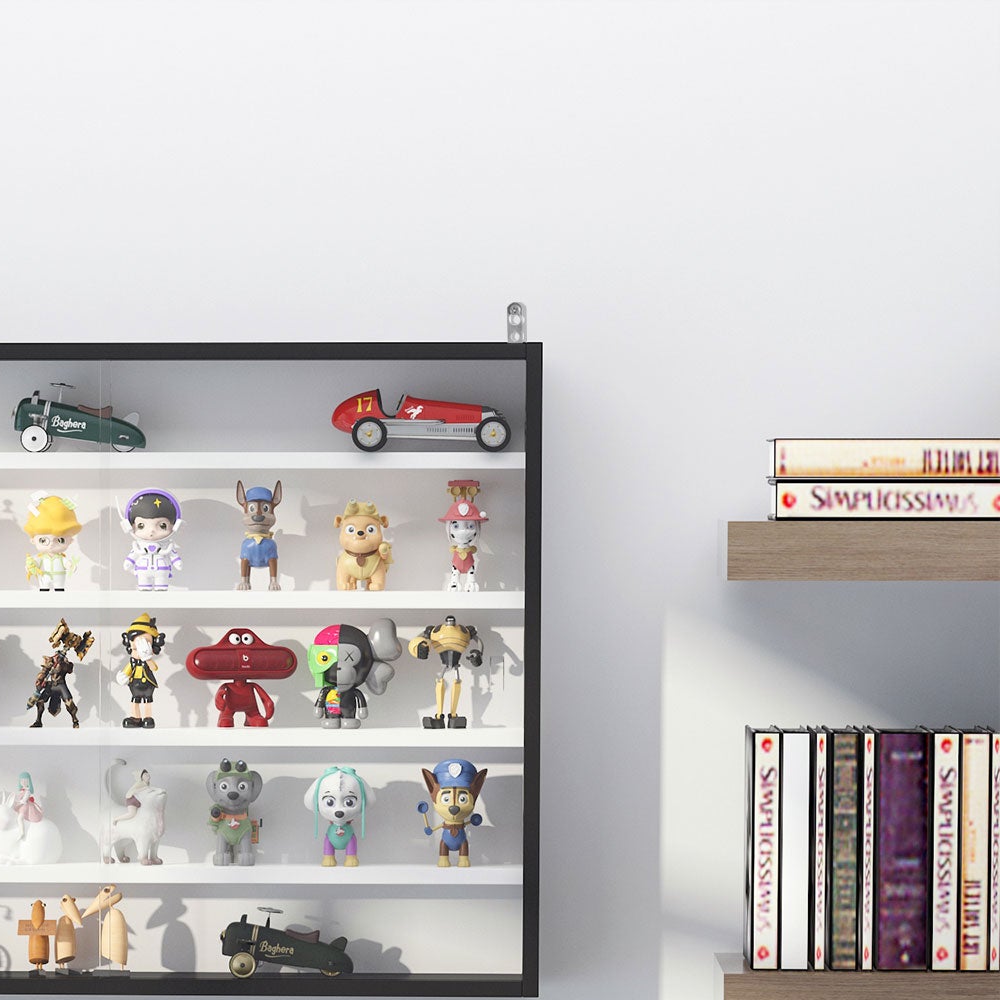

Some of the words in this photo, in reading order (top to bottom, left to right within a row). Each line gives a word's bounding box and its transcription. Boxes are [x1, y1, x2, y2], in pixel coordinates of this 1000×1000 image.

[356, 396, 373, 413] 17
[51, 415, 87, 430] Baghera
[259, 940, 295, 955] Baghera
